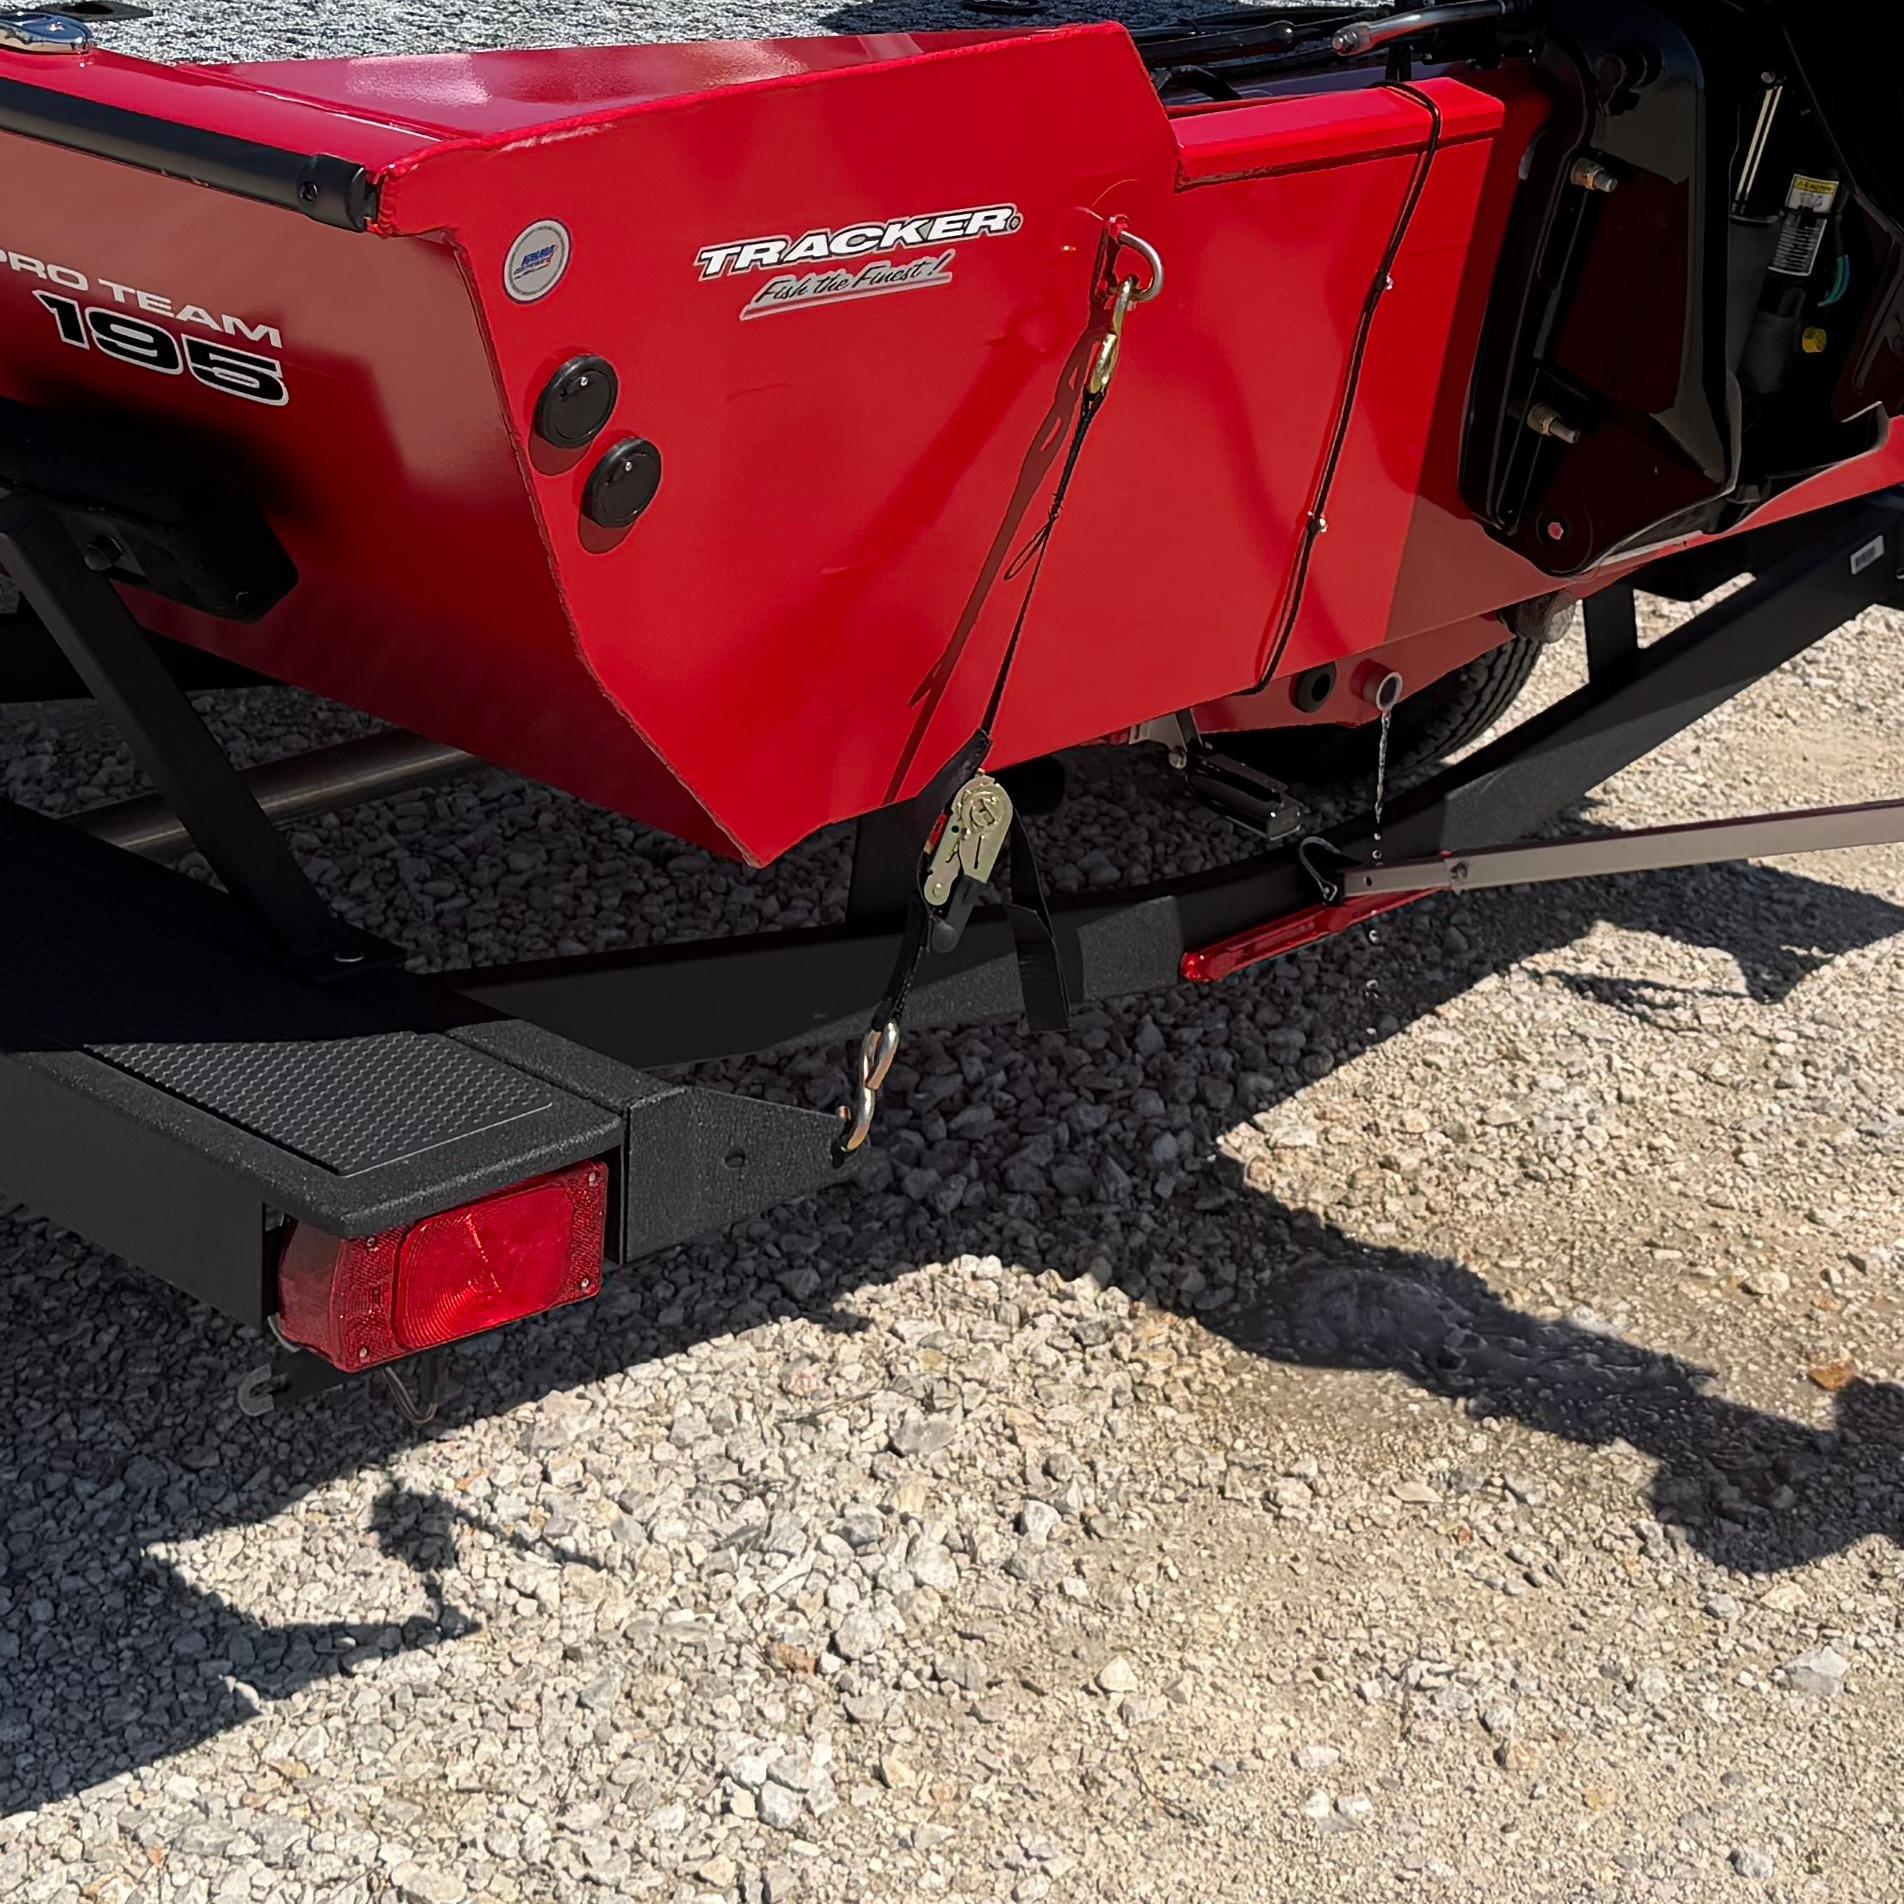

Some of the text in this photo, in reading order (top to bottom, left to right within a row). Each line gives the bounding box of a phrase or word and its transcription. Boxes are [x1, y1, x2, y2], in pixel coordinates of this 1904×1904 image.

[97, 278, 284, 349] TEAM
[754, 279, 809, 303] Fish
[812, 274, 850, 296] the
[32, 289, 290, 407] 195
